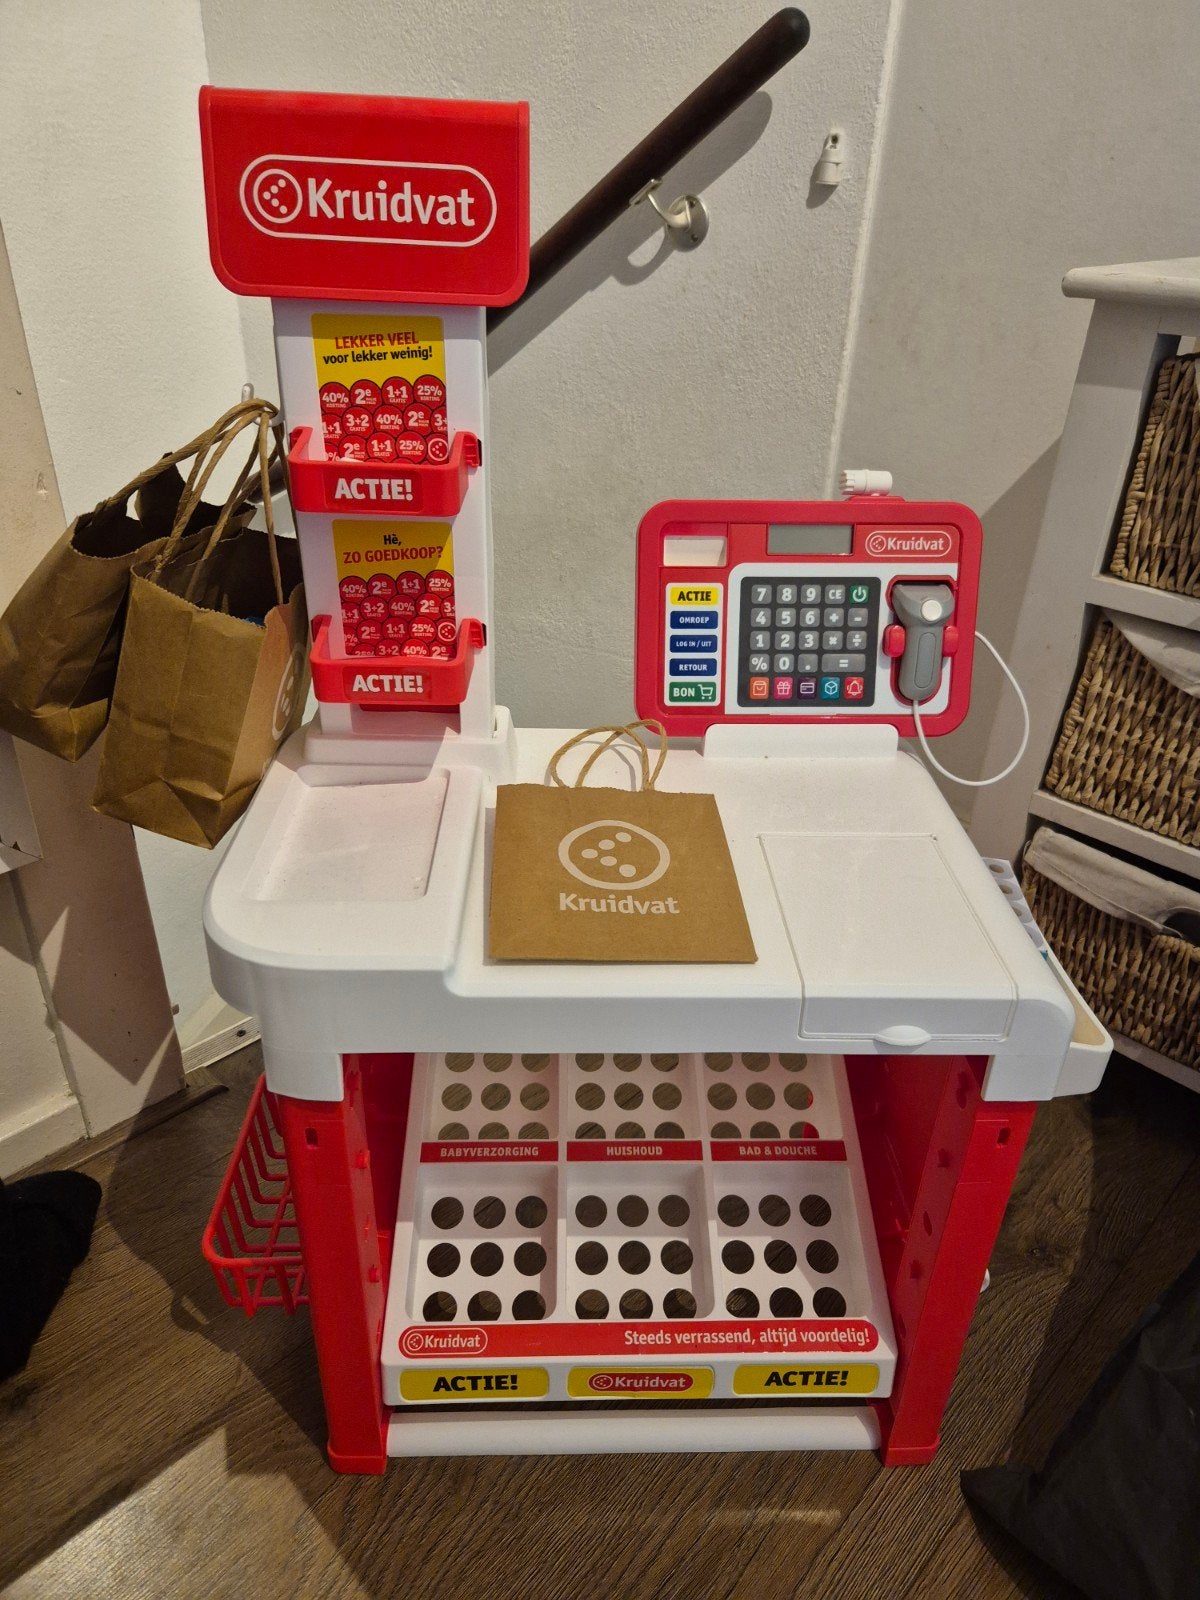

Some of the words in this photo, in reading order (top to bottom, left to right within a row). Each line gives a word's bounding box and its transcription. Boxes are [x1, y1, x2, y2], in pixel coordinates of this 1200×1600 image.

[307, 177, 475, 227] Kruidvat
[335, 333, 385, 349] LEKKER
[387, 331, 419, 346] VEEL
[323, 354, 349, 364] voor
[351, 350, 388, 362] lekker
[390, 346, 433, 361] weinig!
[386, 385, 408, 398] 1+1
[417, 385, 442, 396] 25%
[322, 392, 349, 403] 40%
[346, 414, 370, 427] 3+2
[376, 414, 402, 425] 40%
[371, 440, 393, 452] 1+1
[400, 440, 424, 451] 25%
[335, 477, 414, 501] ACTIE!
[383, 534, 402, 546] Hè,
[887, 536, 944, 551] Kruidvat
[343, 551, 361, 564] ZO
[365, 546, 444, 563] GOEDKOOP?
[342, 584, 367, 594] 40%
[401, 578, 420, 589] 1+1
[428, 578, 451, 588] 25%
[677, 591, 712, 601] ACTIE
[757, 588, 767, 602] 7
[781, 587, 792, 602] 8
[806, 587, 816, 602] 9
[828, 589, 842, 600] CE
[363, 602, 384, 613] 3+2
[391, 602, 414, 612] 40%
[679, 616, 710, 624] OMROEP
[755, 610, 766, 625] 4
[781, 611, 791, 625] 5
[805, 610, 815, 625] 6
[387, 623, 405, 634] 1+1
[412, 623, 434, 633] 25%
[756, 634, 764, 648] 1
[780, 634, 790, 648] 2
[805, 634, 814, 648] 3
[403, 645, 427, 655] 40%
[751, 656, 768, 671] %
[779, 657, 790, 670] 0
[352, 674, 424, 693] ACTIE!
[673, 687, 695, 697] BON
[559, 892, 680, 915] Kruidvat
[440, 1146, 539, 1157] BABYVERZORGING
[606, 1145, 663, 1156] HUISHOUD
[739, 1146, 762, 1156] BAD
[764, 1146, 772, 1156] &
[775, 1145, 818, 1156] DOUCHE
[424, 1333, 481, 1349] Kruidvat
[624, 1329, 672, 1346] Steeds
[674, 1328, 756, 1345] verrassend,
[759, 1327, 797, 1347] altijd
[799, 1327, 870, 1346] voordelig!
[433, 1374, 519, 1392] ACTIE!
[615, 1376, 686, 1388] Kruidvat
[764, 1370, 849, 1387] ACTIE!
